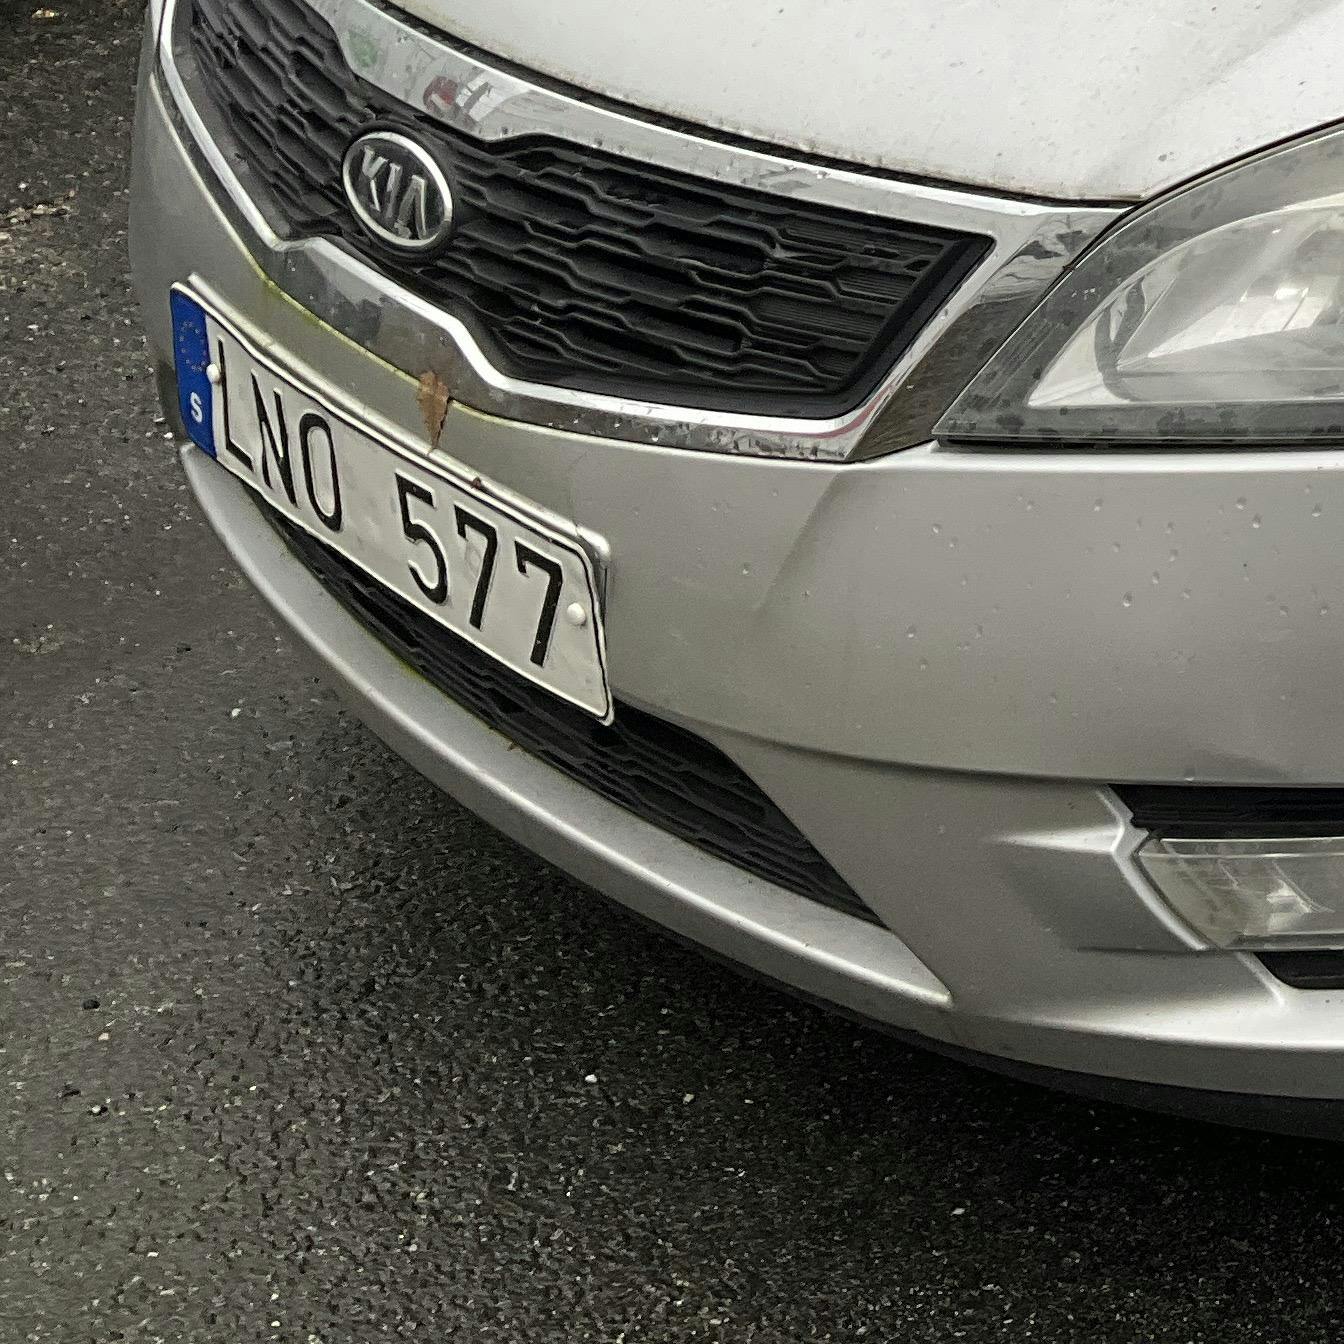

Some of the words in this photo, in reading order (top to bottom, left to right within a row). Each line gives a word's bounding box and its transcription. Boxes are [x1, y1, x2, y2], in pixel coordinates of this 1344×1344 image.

[189, 391, 203, 423] S
[216, 336, 344, 533] LNO
[395, 468, 566, 668] 577
